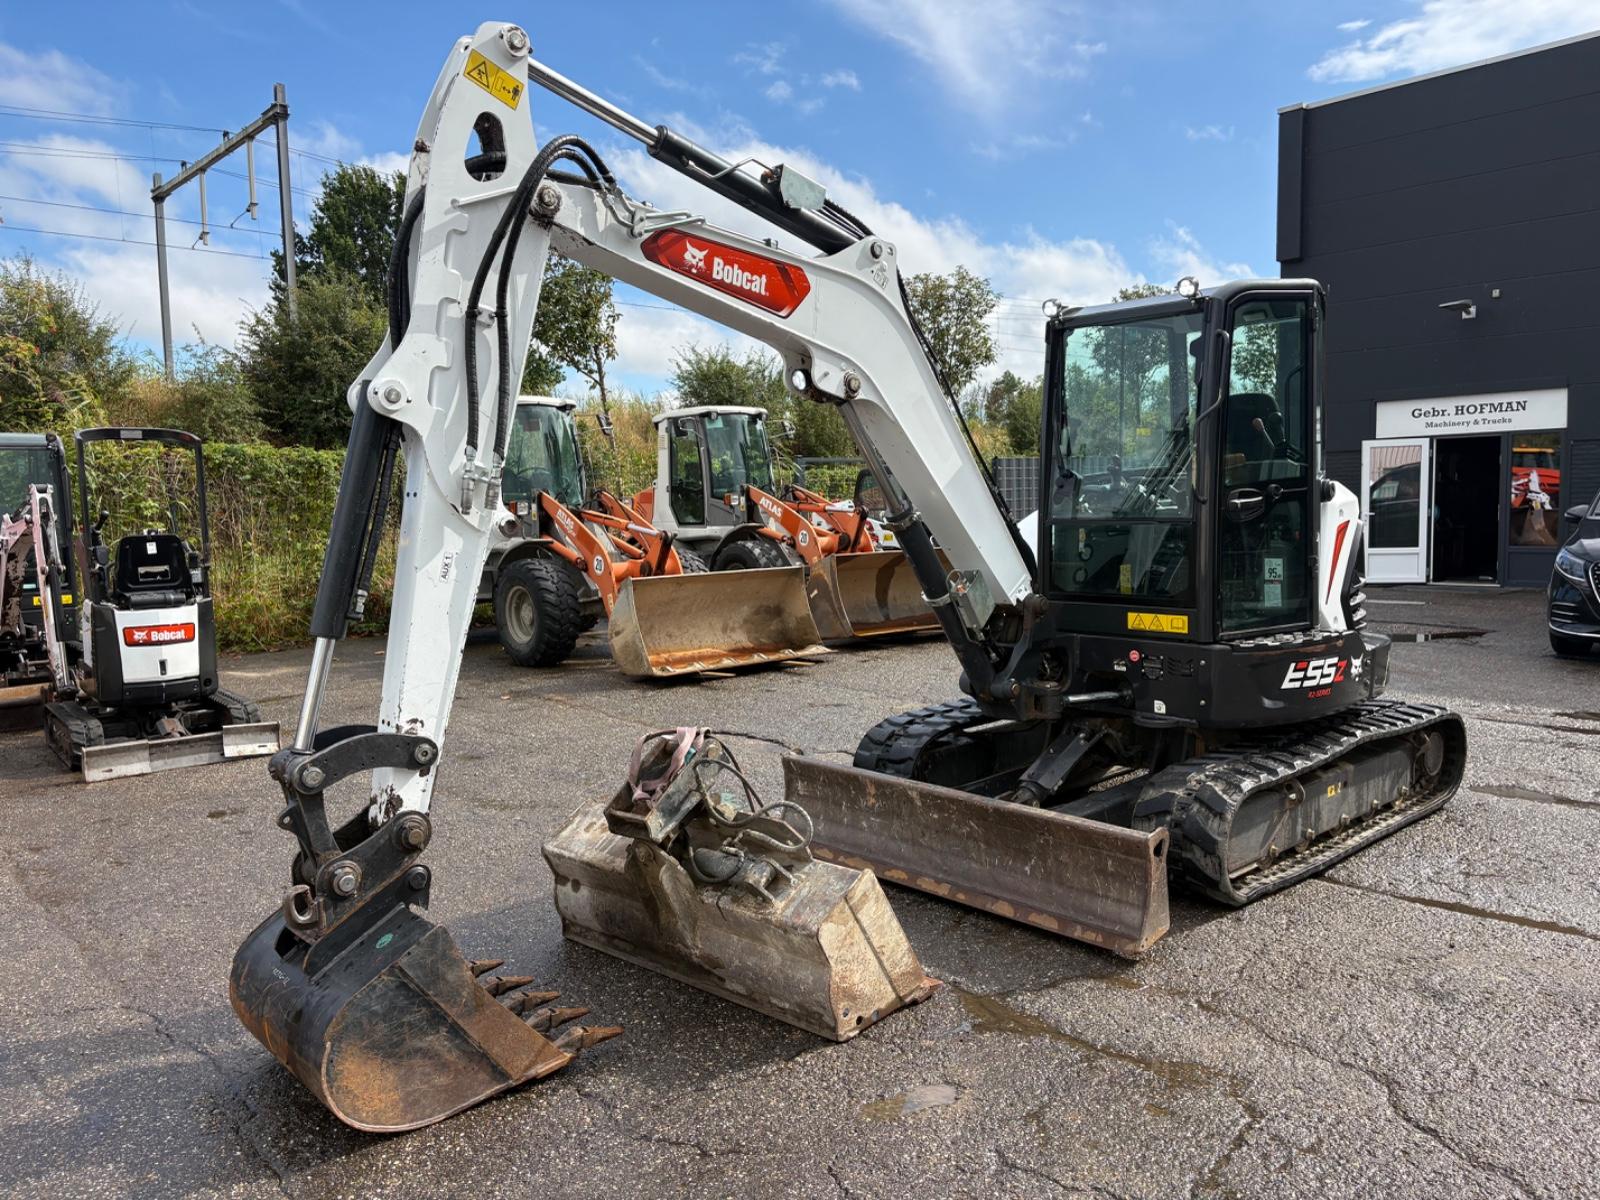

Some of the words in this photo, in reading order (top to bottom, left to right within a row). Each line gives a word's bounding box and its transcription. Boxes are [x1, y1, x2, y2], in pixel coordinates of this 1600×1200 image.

[712, 256, 768, 296] Bobcat
[1411, 407, 1451, 419] Gebr.
[1454, 400, 1528, 416] HOFMAN
[1424, 419, 1471, 429] Machinery
[1473, 418, 1479, 426] &
[1481, 417, 1512, 425] Trucks
[760, 497, 782, 517] ATLAS
[800, 532, 808, 544] 20
[595, 557, 603, 572] 20
[1268, 567, 1278, 578] 95
[151, 630, 185, 642] Bobcat
